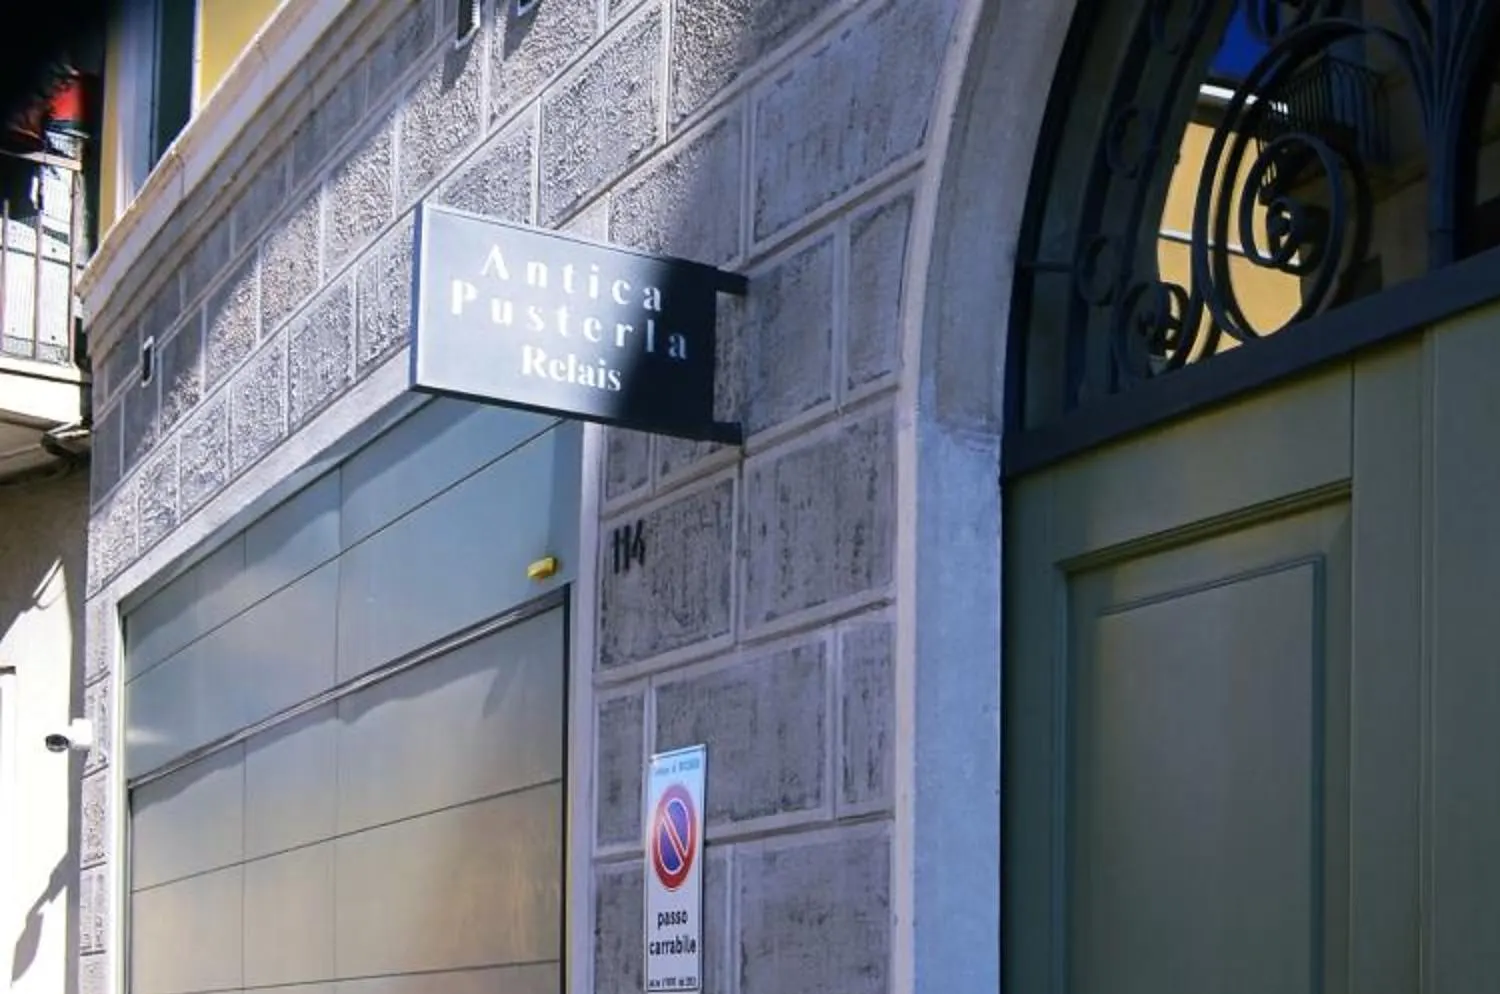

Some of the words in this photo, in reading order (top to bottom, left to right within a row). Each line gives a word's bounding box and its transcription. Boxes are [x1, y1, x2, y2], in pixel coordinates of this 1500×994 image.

[481, 243, 663, 312] Antica
[451, 279, 688, 360] Pusterla
[520, 343, 622, 391] Relais
[656, 909, 689, 931] passo
[649, 934, 697, 957] carrabile
